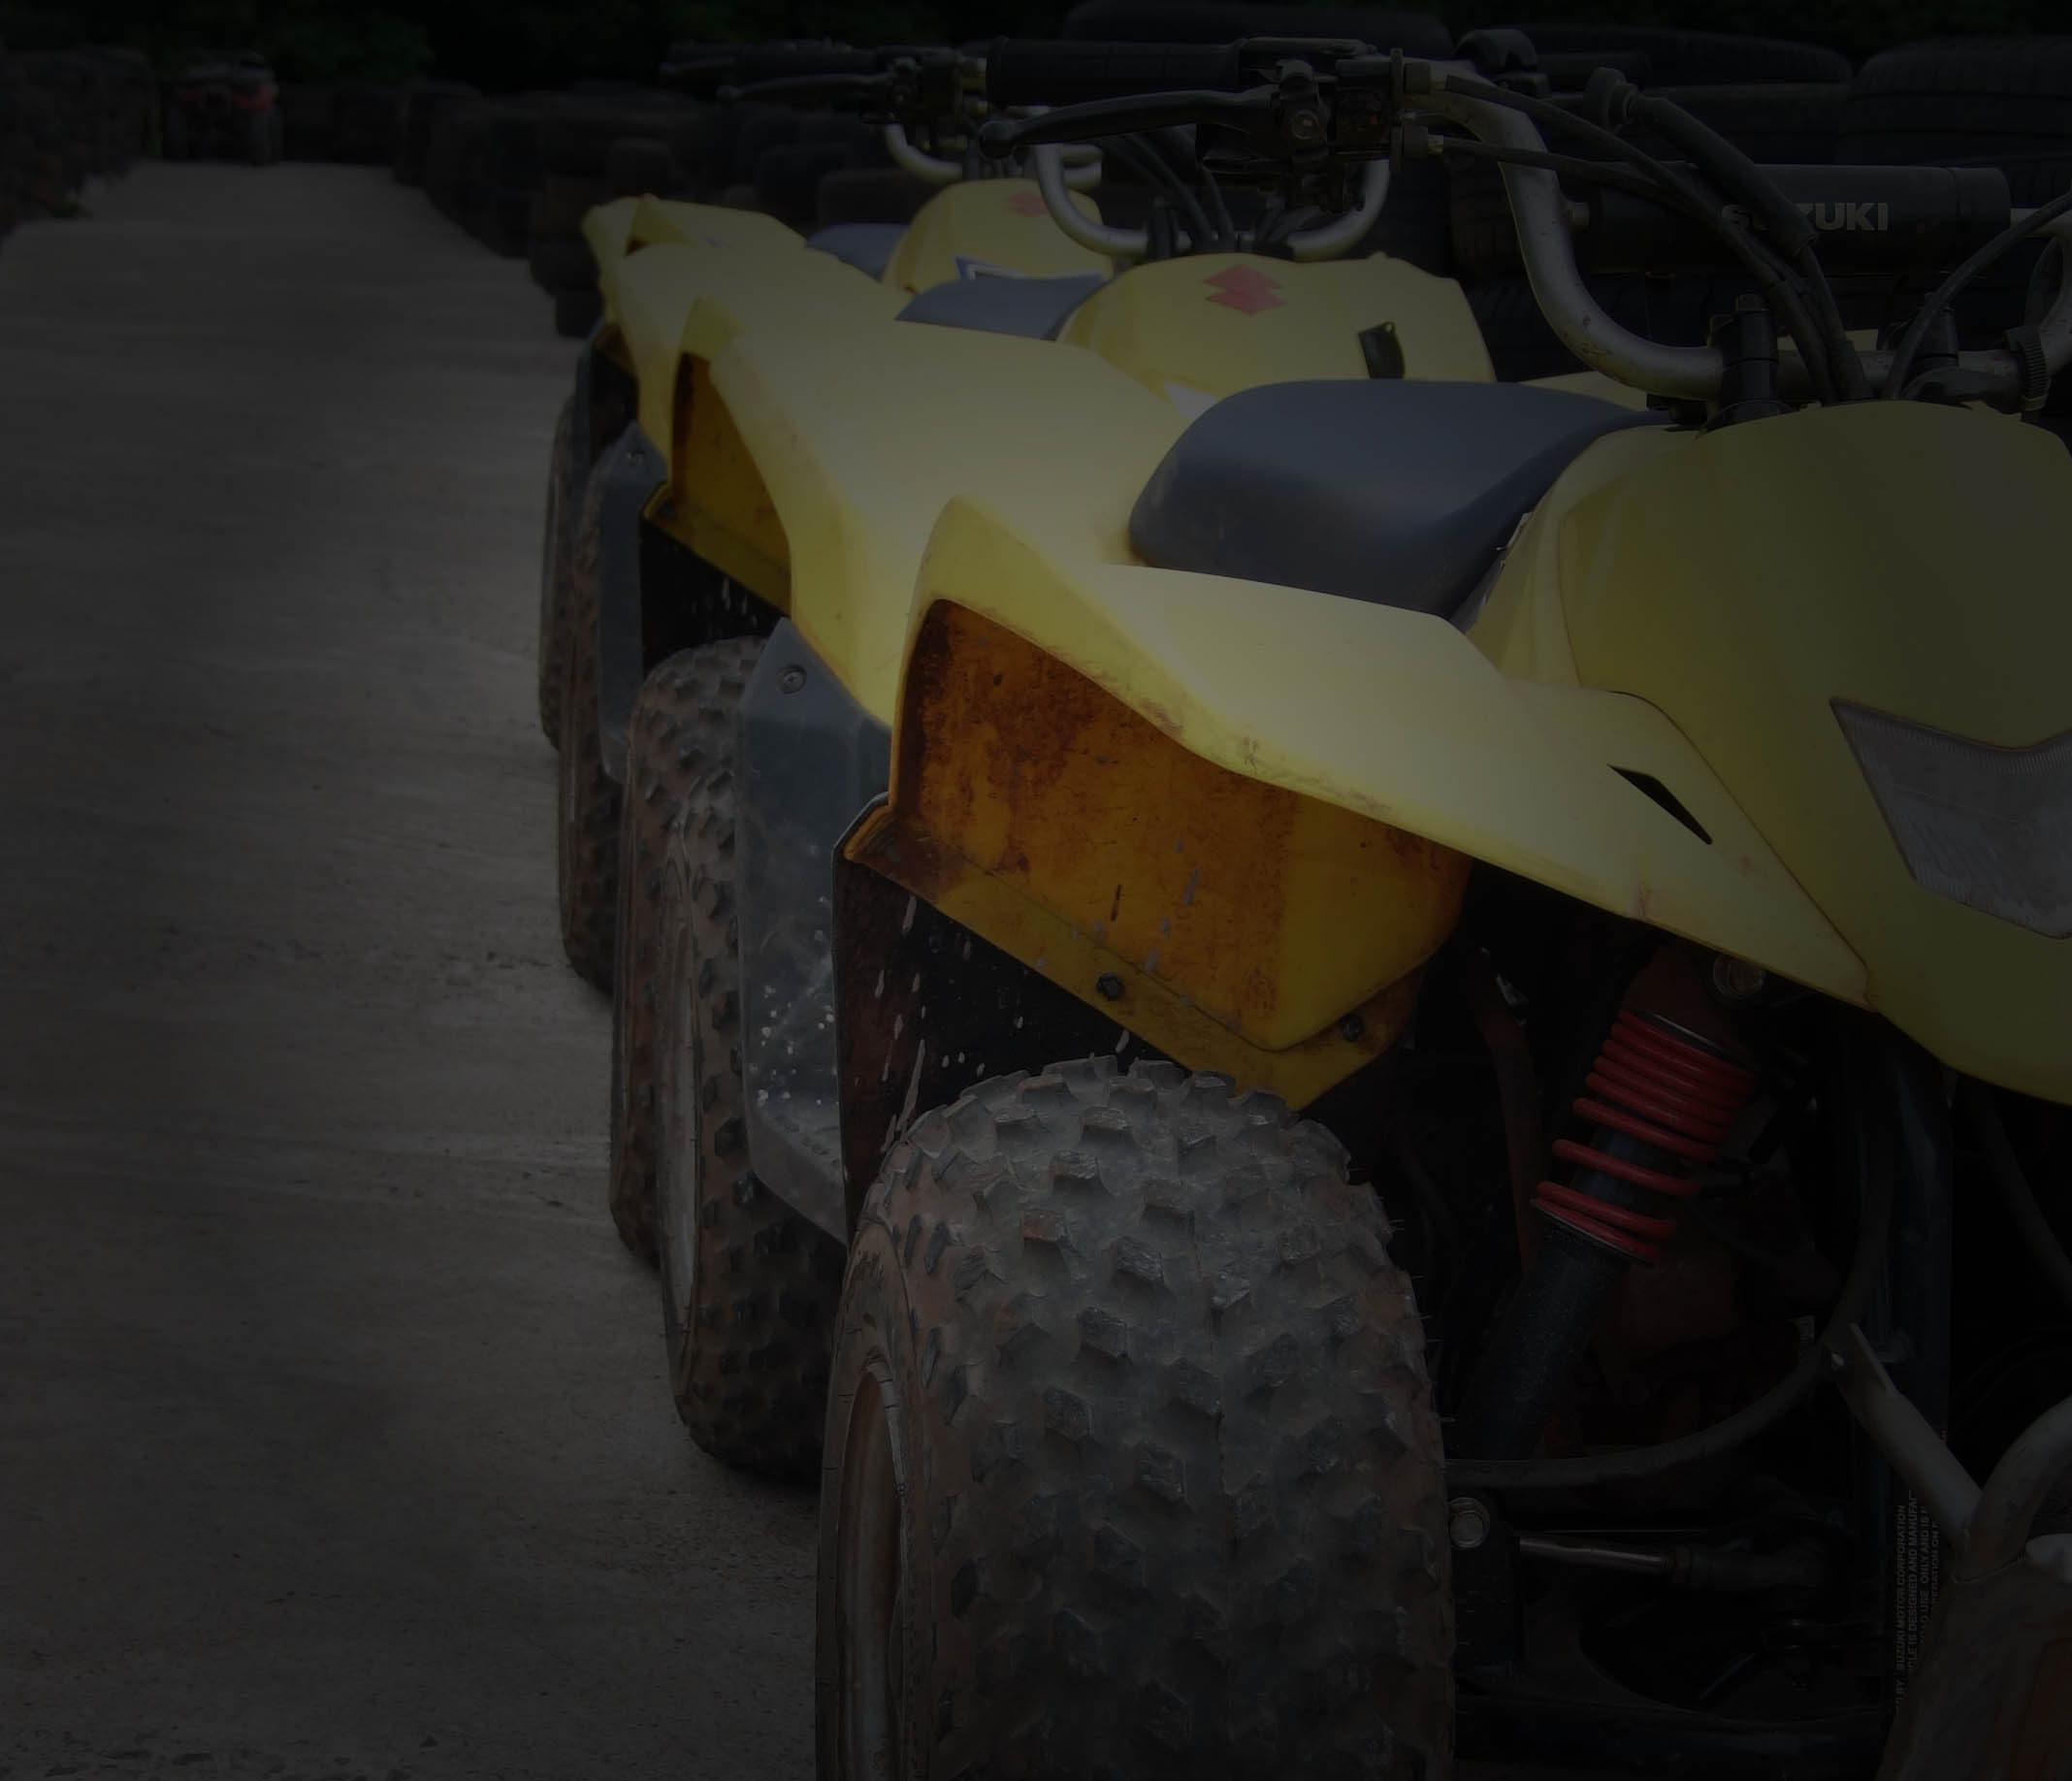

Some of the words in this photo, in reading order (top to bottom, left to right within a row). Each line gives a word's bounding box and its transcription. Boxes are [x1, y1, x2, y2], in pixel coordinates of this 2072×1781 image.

[1722, 202, 1890, 232] SUKI
[1895, 1506, 1906, 1585] CORPORATION
[1920, 1529, 1929, 1553] AND
[1908, 1549, 1918, 1573] AND
[1920, 1553, 1929, 1584] ONLY
[1895, 1588, 1906, 1629] MOTOR
[1908, 1574, 1918, 1632] DESIGNED
[1920, 1591, 1929, 1612] USE
[1895, 1631, 1906, 1670] SUZUKI
